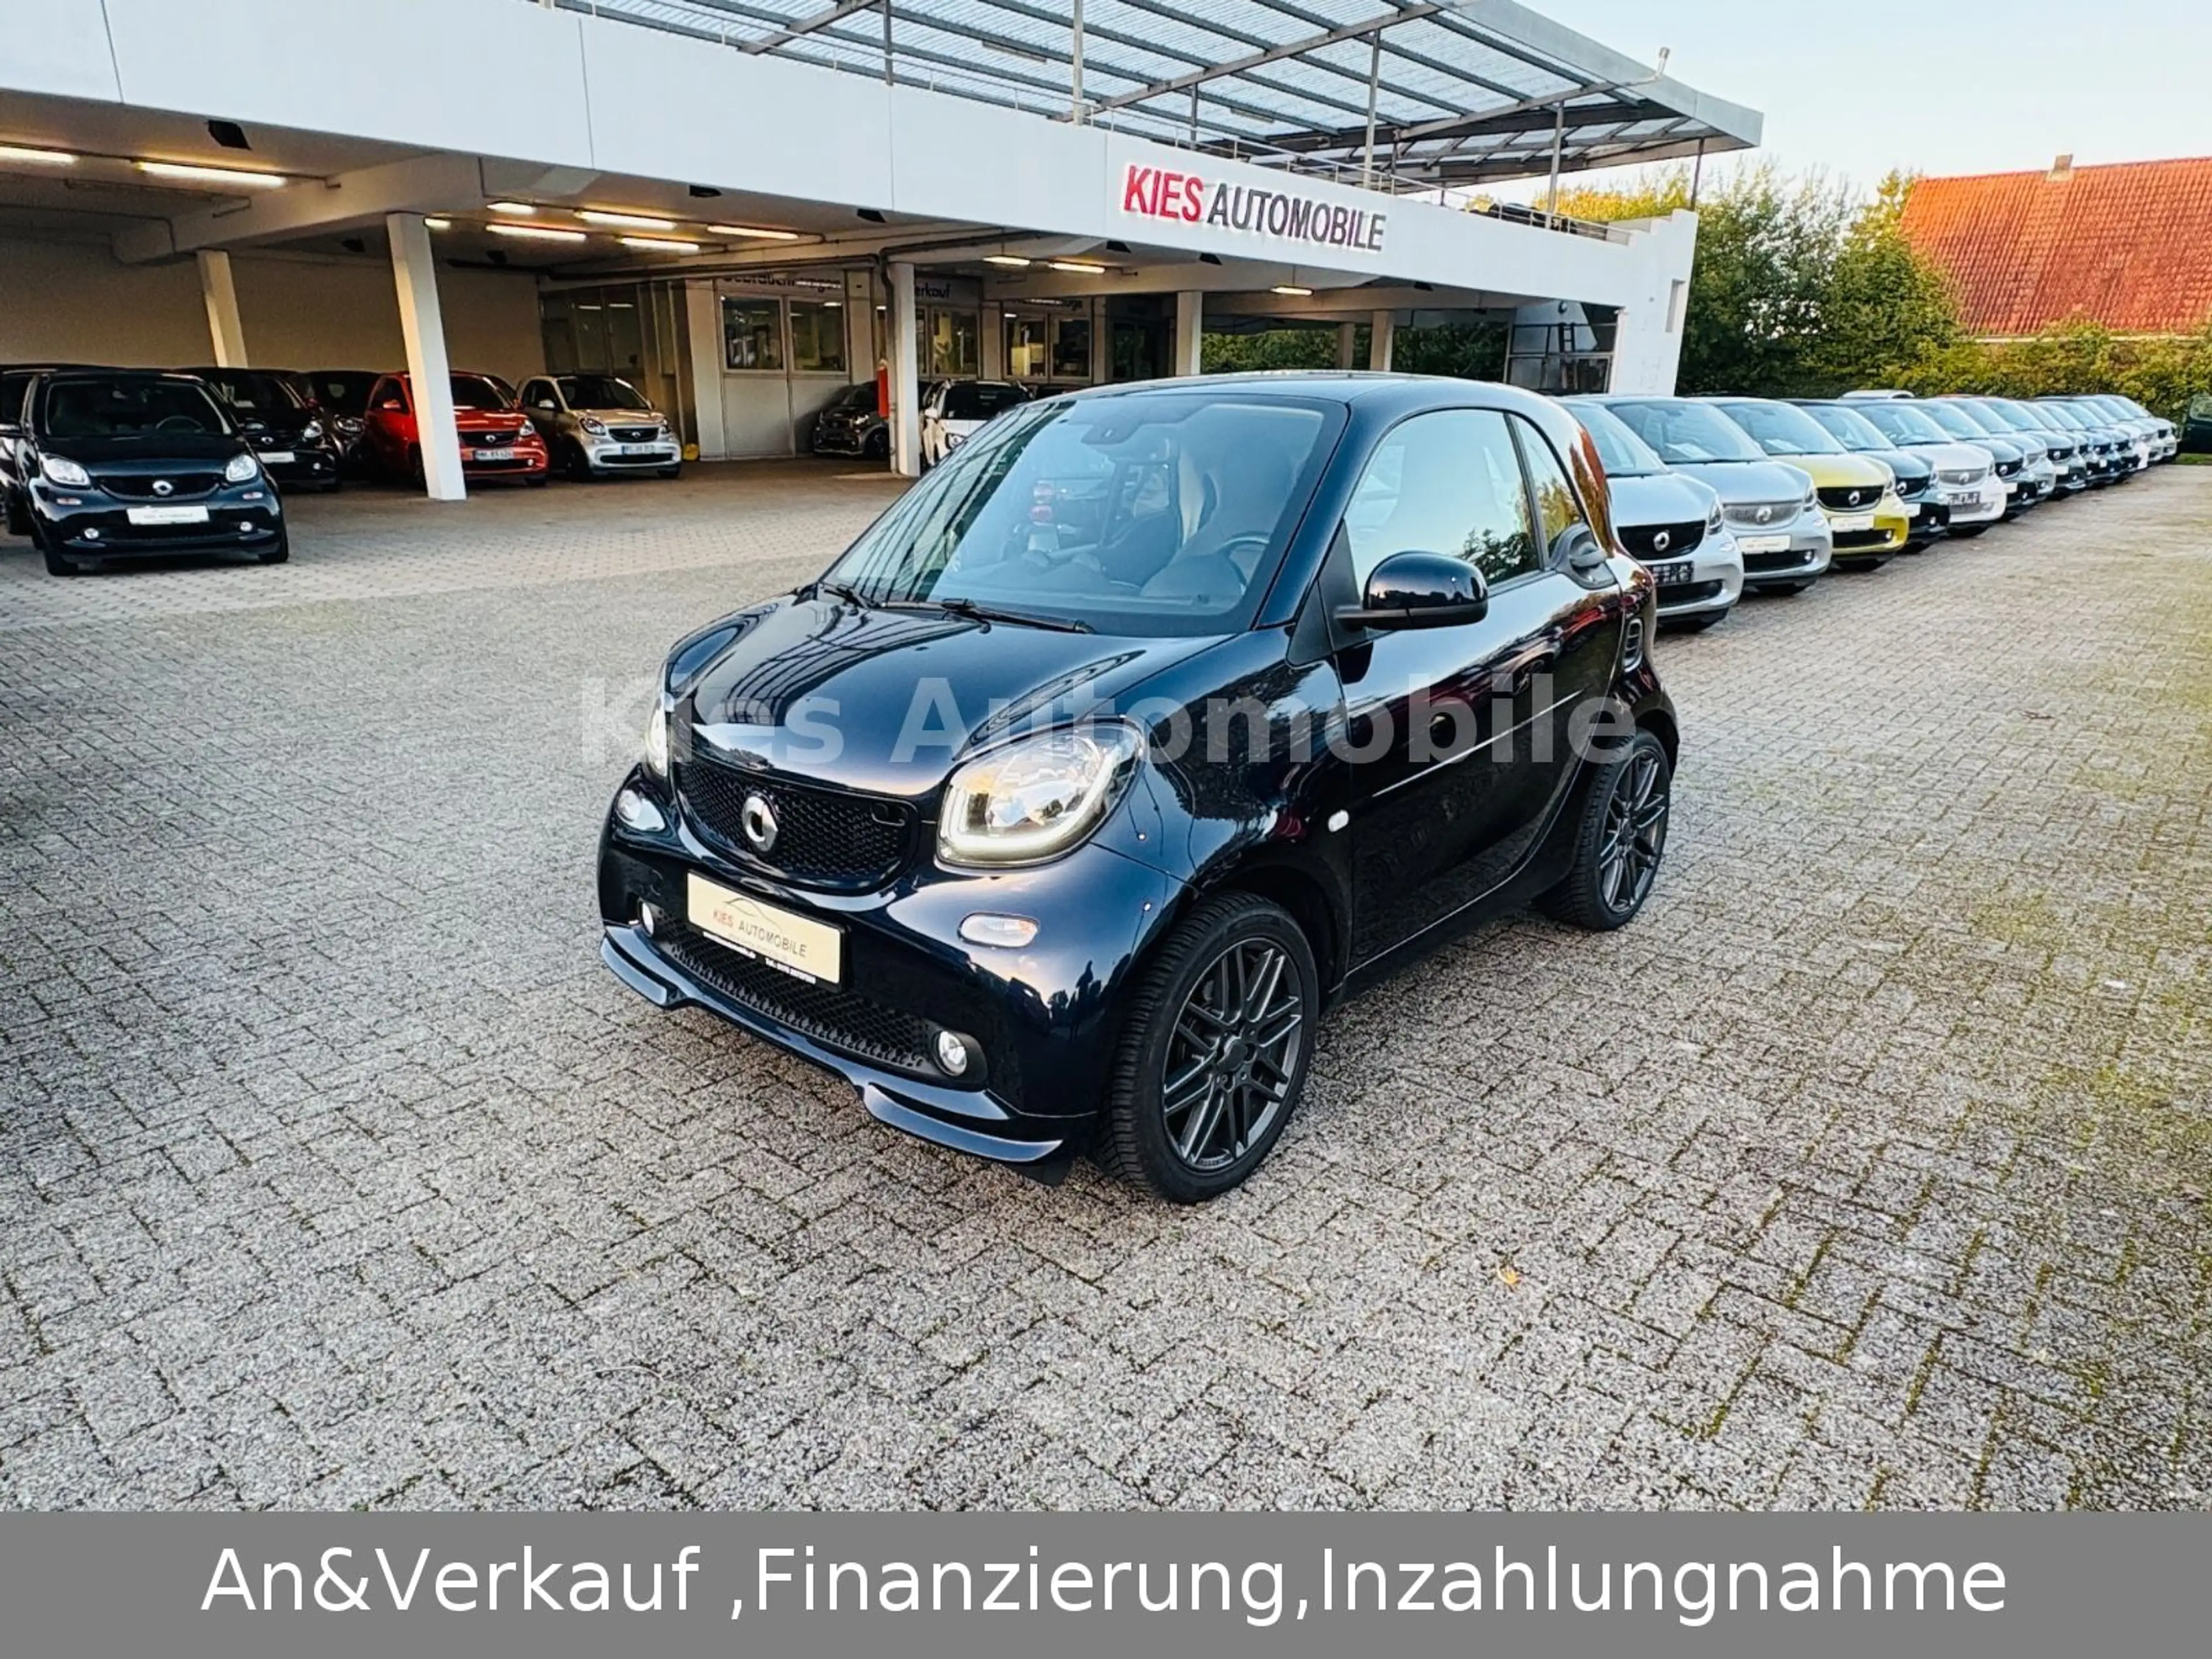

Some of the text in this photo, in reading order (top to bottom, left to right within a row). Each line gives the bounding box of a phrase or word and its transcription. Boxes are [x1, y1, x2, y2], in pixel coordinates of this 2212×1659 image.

[1123, 165, 1387, 252] KIES AUTOMOBILE
[914, 282, 951, 298] erkauf
[713, 910, 734, 927] KIES
[738, 921, 808, 958] AUTOMOBILE
